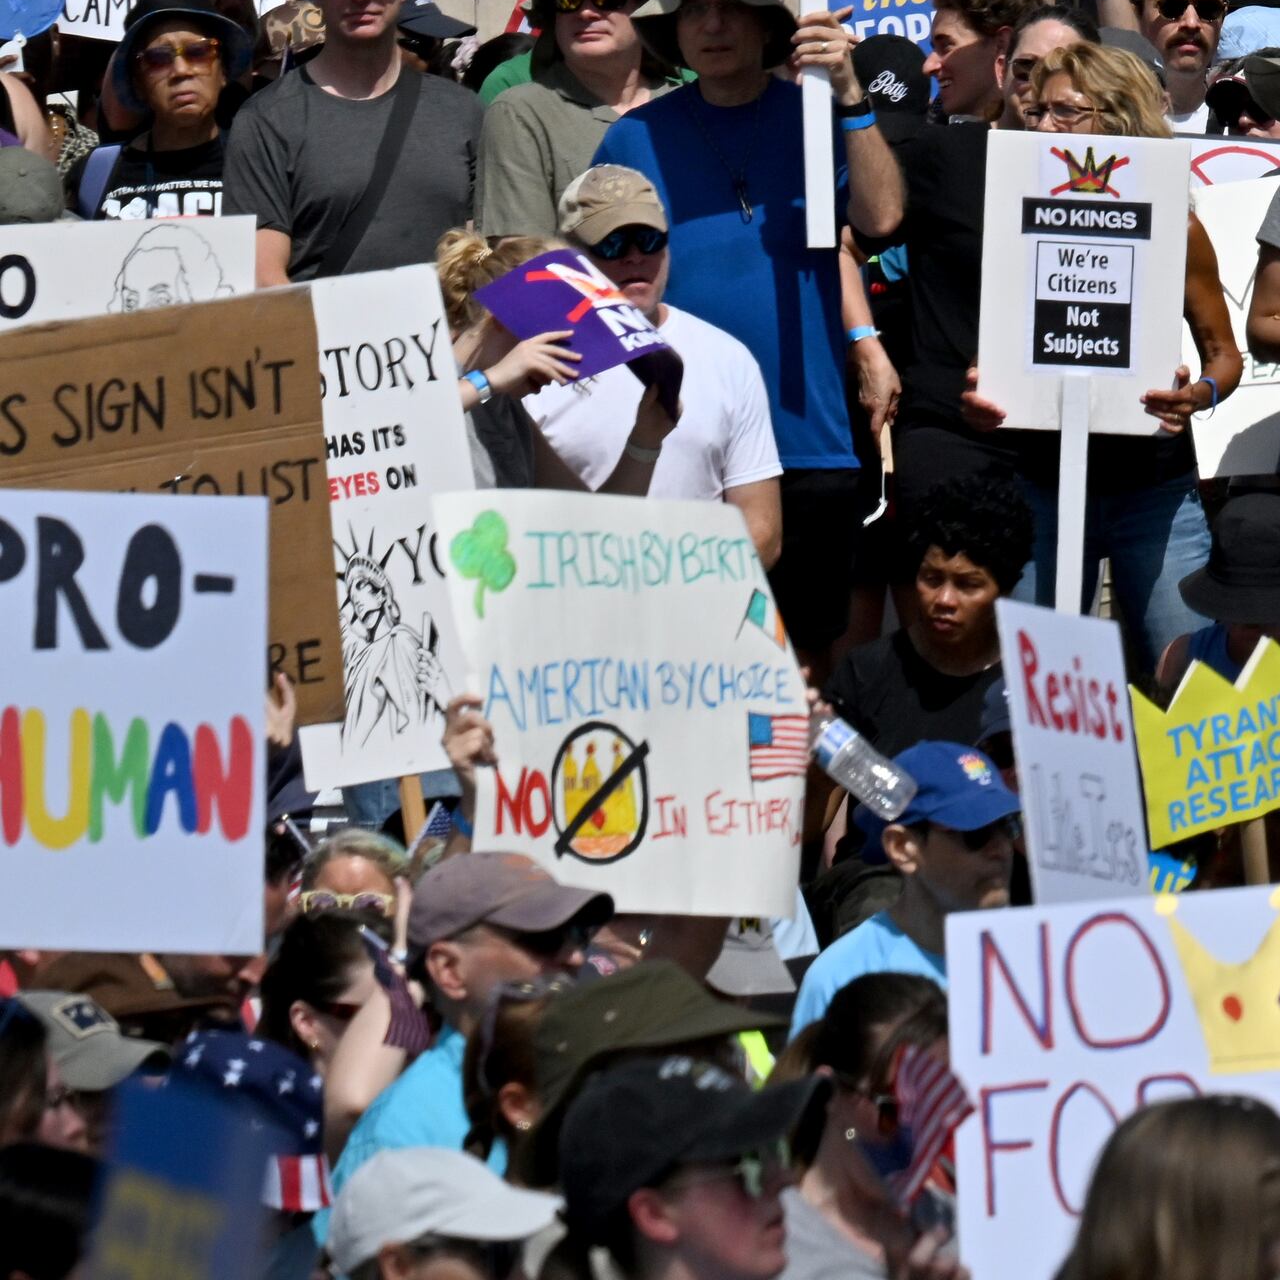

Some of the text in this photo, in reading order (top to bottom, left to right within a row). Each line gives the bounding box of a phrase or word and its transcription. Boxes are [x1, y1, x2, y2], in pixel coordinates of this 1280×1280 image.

[867, 70, 908, 103] Petty
[1034, 209, 1138, 230] NO KINGS
[1057, 250, 1109, 269] We're
[1046, 273, 1118, 297] Citizens
[1066, 306, 1099, 327] Not
[1042, 332, 1120, 359] Subjects
[53, 347, 296, 447] SIGN ISN'T
[326, 422, 407, 458] HAS ITS
[328, 464, 418, 502] EYES ON
[486, 660, 792, 729] AMERICAN CHOICE
[1015, 629, 1124, 744] Resist
[494, 768, 551, 839] NO
[980, 912, 1171, 1055] NO
